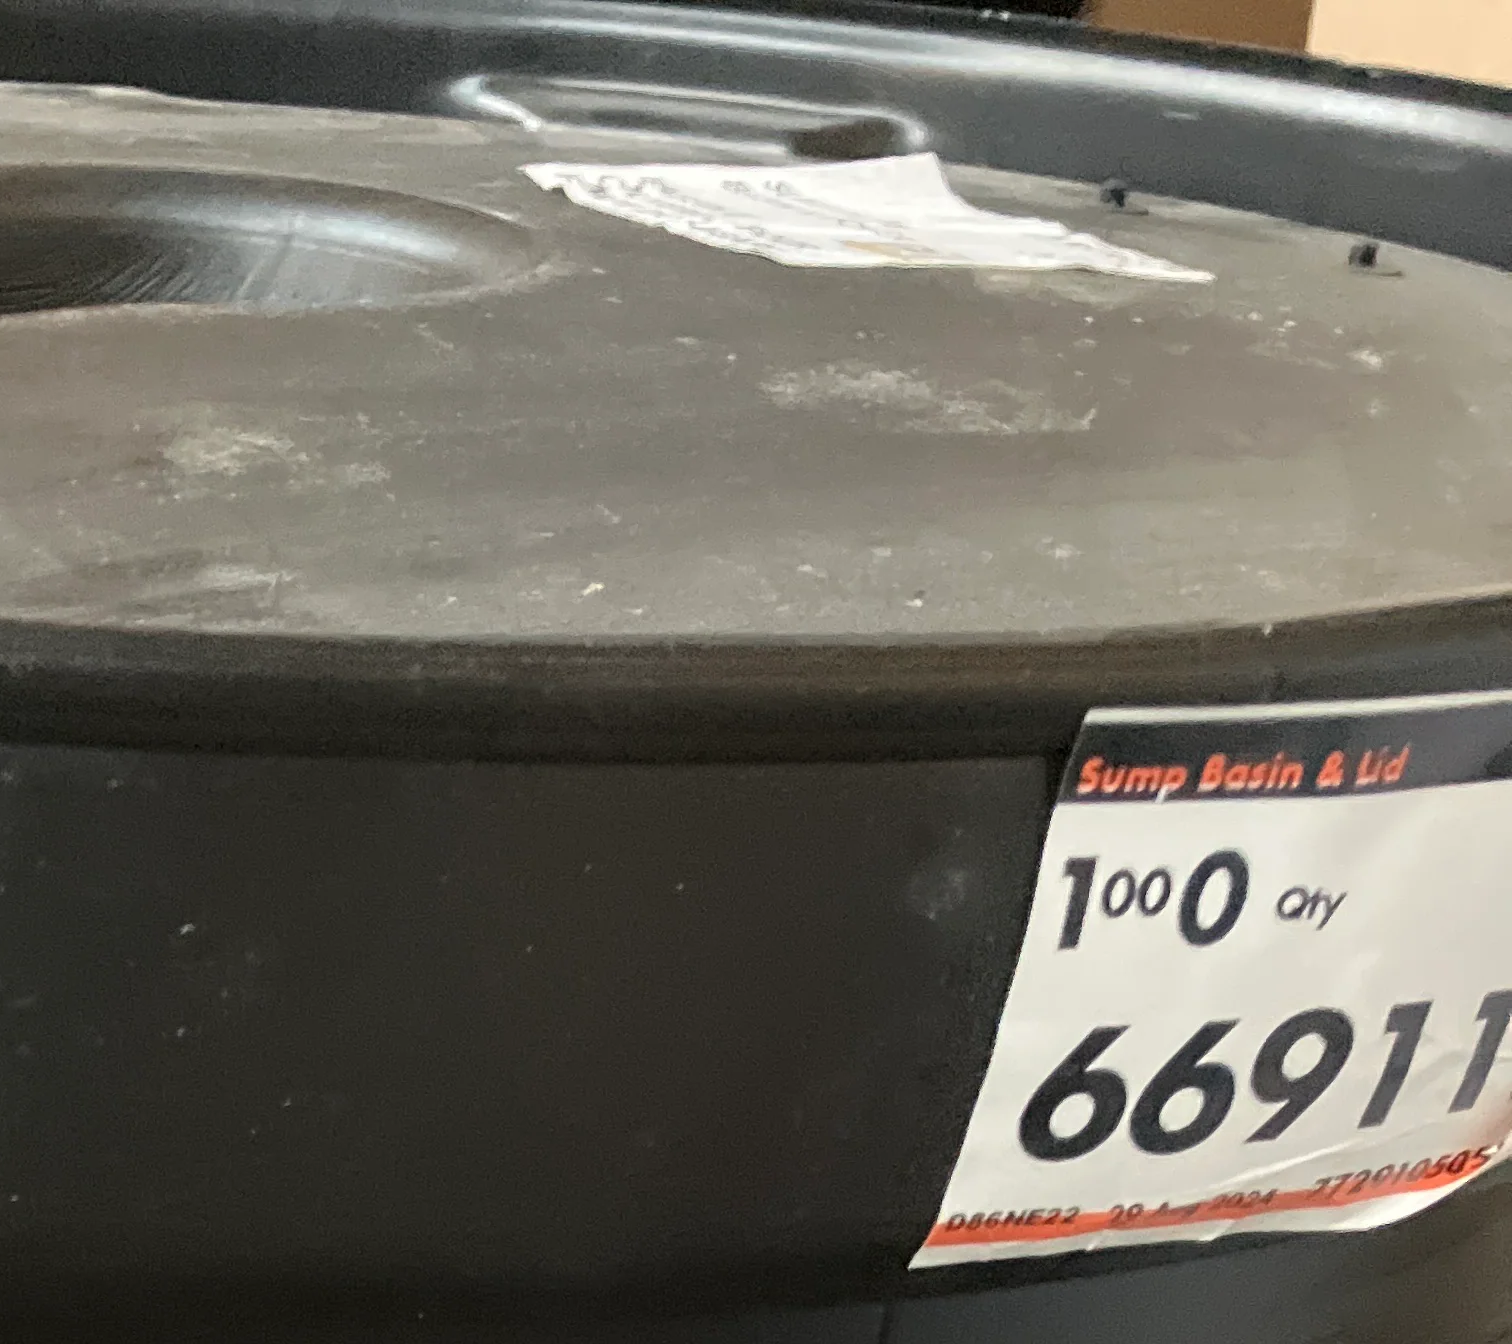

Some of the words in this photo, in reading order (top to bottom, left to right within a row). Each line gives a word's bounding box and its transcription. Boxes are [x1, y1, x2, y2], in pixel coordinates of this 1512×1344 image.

[1077, 757, 1187, 802] Sump
[1198, 752, 1304, 793] Basin
[1316, 751, 1344, 788] &
[1355, 743, 1410, 787] Lid
[1276, 885, 1347, 931] Qty
